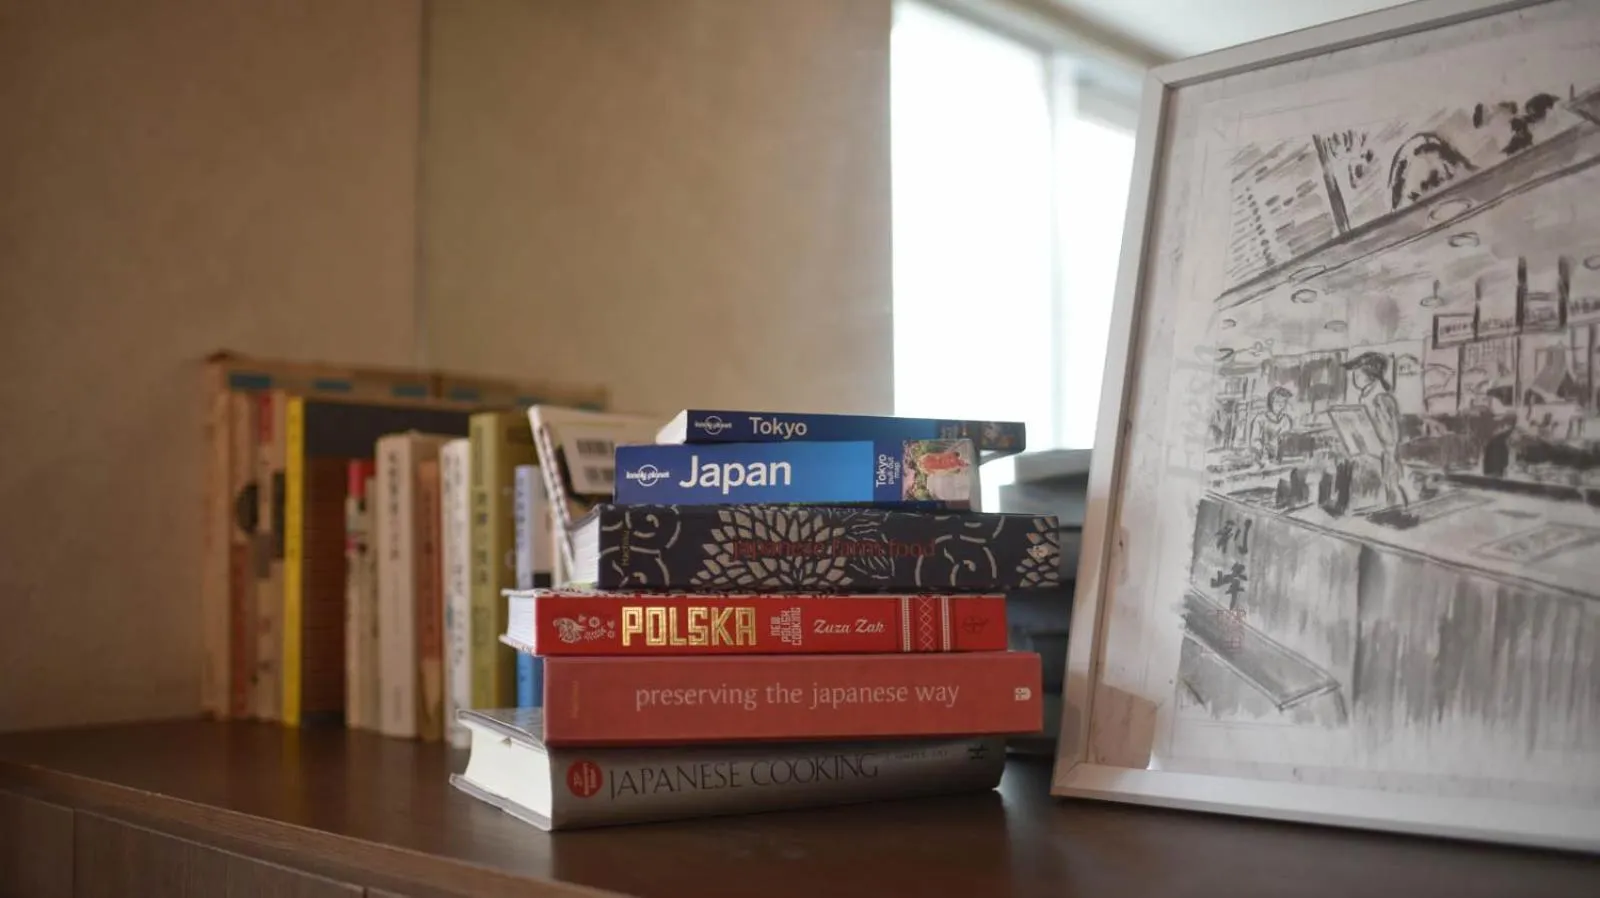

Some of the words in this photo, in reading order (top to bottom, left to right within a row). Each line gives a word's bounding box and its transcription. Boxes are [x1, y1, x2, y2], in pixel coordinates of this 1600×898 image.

[748, 416, 808, 440] Tokyo
[626, 471, 647, 481] lonely
[647, 471, 670, 481] planet
[678, 454, 792, 495] Japan
[875, 453, 889, 488] Tokyo
[888, 539, 936, 558] food
[621, 605, 757, 647] POLSKA
[780, 610, 791, 643] POLISH
[790, 607, 802, 646] COOKING
[813, 618, 851, 634] Zuza
[635, 682, 758, 712] preserving
[767, 681, 804, 705] the
[808, 680, 908, 711] japanese
[914, 682, 960, 708] way
[609, 759, 742, 800] JAPANESE
[749, 752, 879, 787] COOKING
